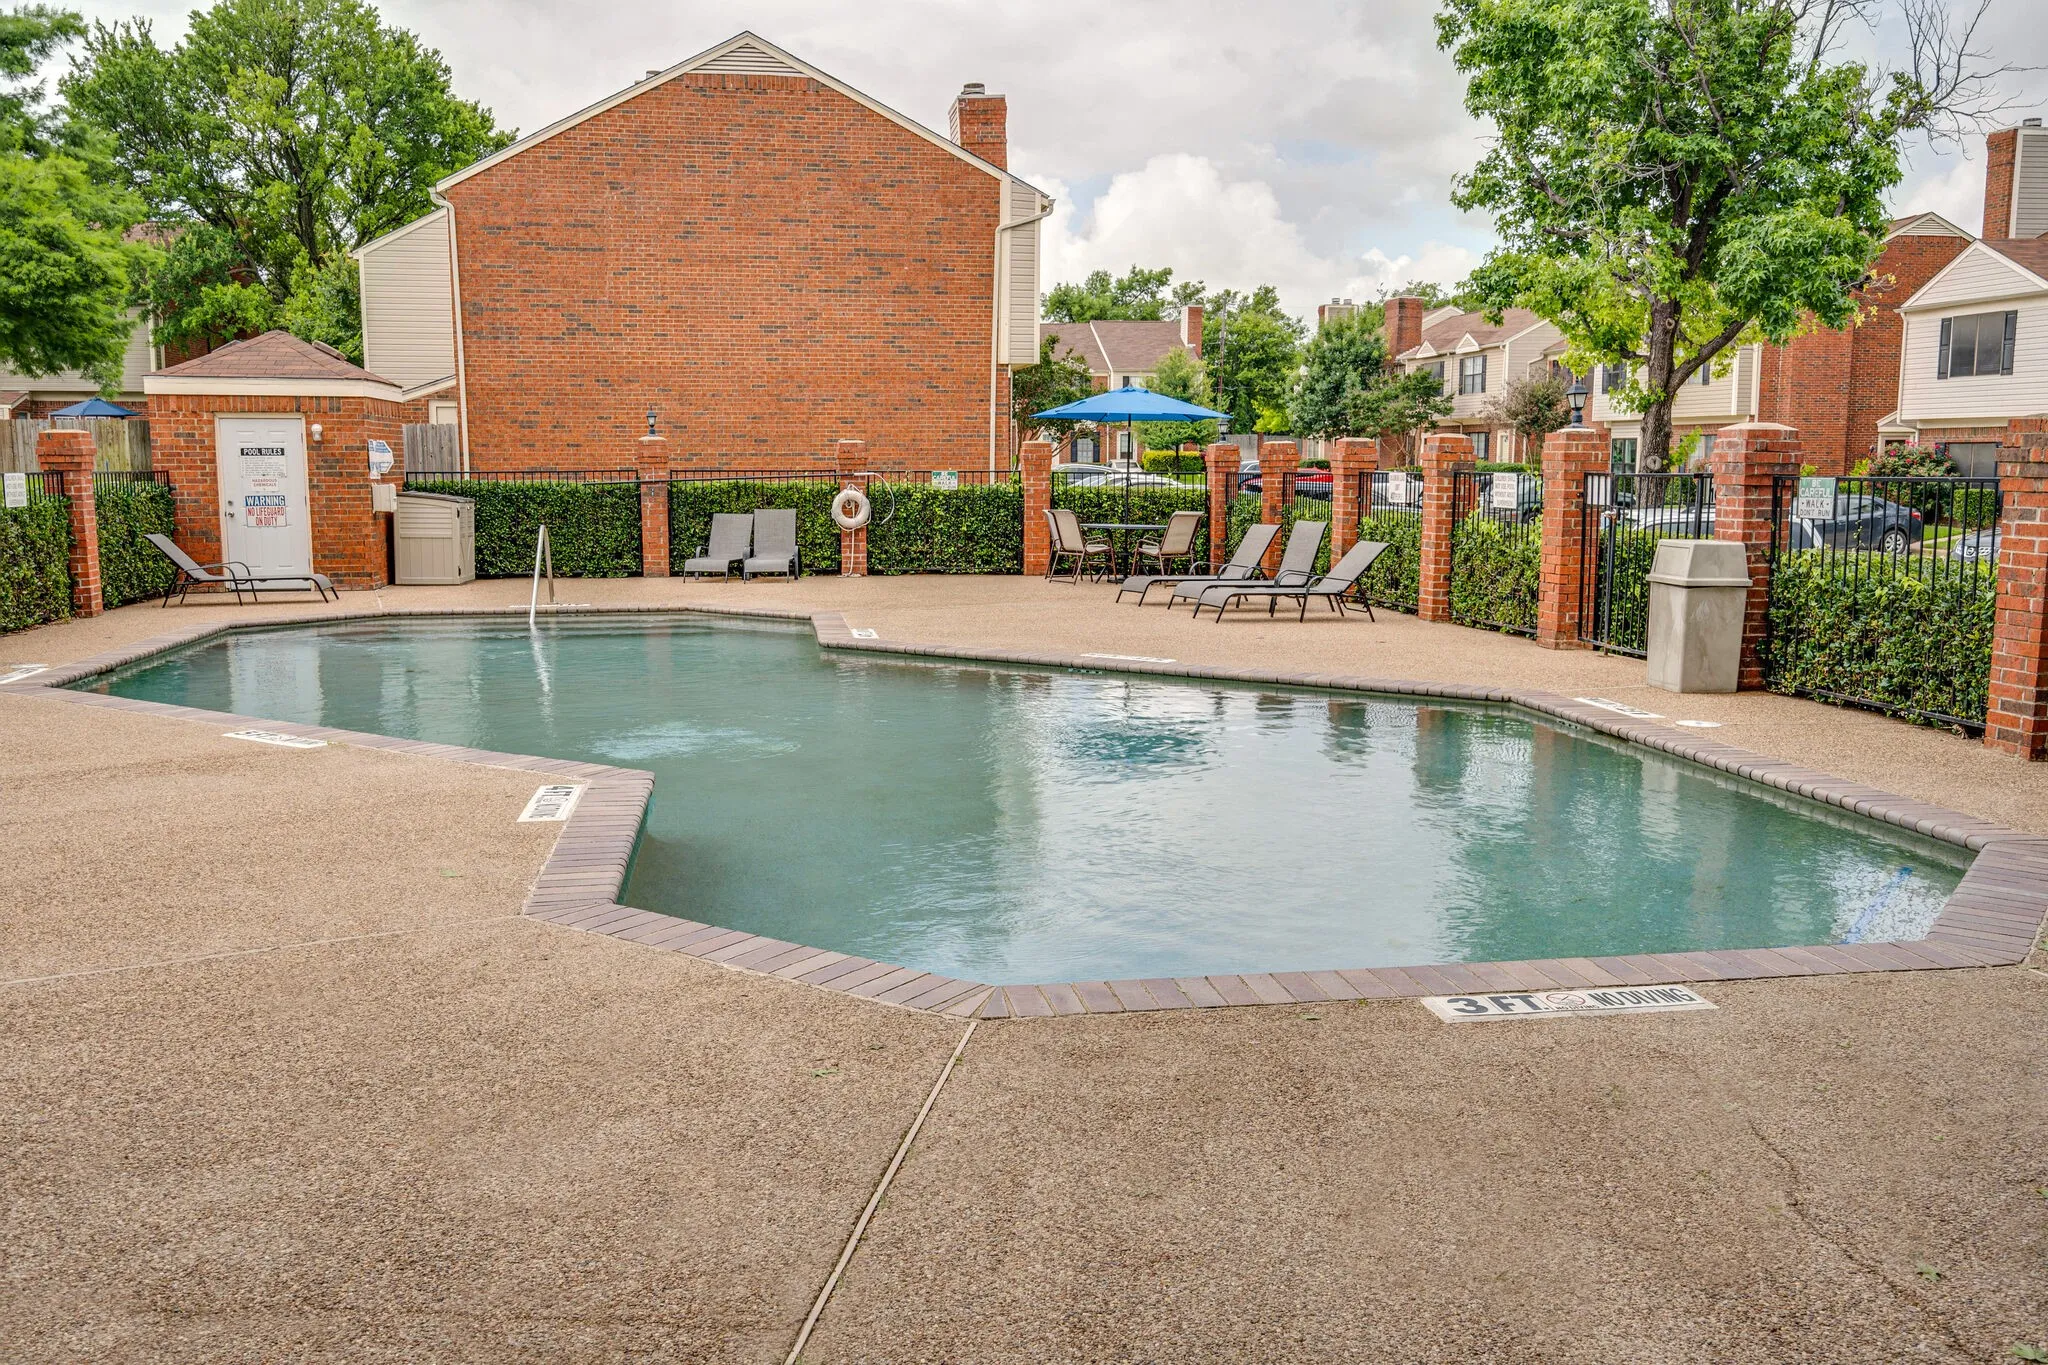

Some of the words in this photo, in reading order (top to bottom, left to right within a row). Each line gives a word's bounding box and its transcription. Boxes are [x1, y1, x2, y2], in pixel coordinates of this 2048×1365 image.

[1811, 479, 1822, 487] BE
[1800, 487, 1833, 498] CAREFUL
[246, 495, 285, 506] WARNING
[1806, 499, 1825, 508] WALK
[247, 507, 255, 516] NO
[256, 507, 285, 516] LIFEGUARD
[1818, 509, 1830, 517] RUN
[255, 516, 263, 525] ON
[264, 516, 277, 525] DUTY
[1588, 992, 1626, 1007] NO
[1615, 987, 1698, 1005] DIVING
[1447, 997, 1489, 1014] 3
